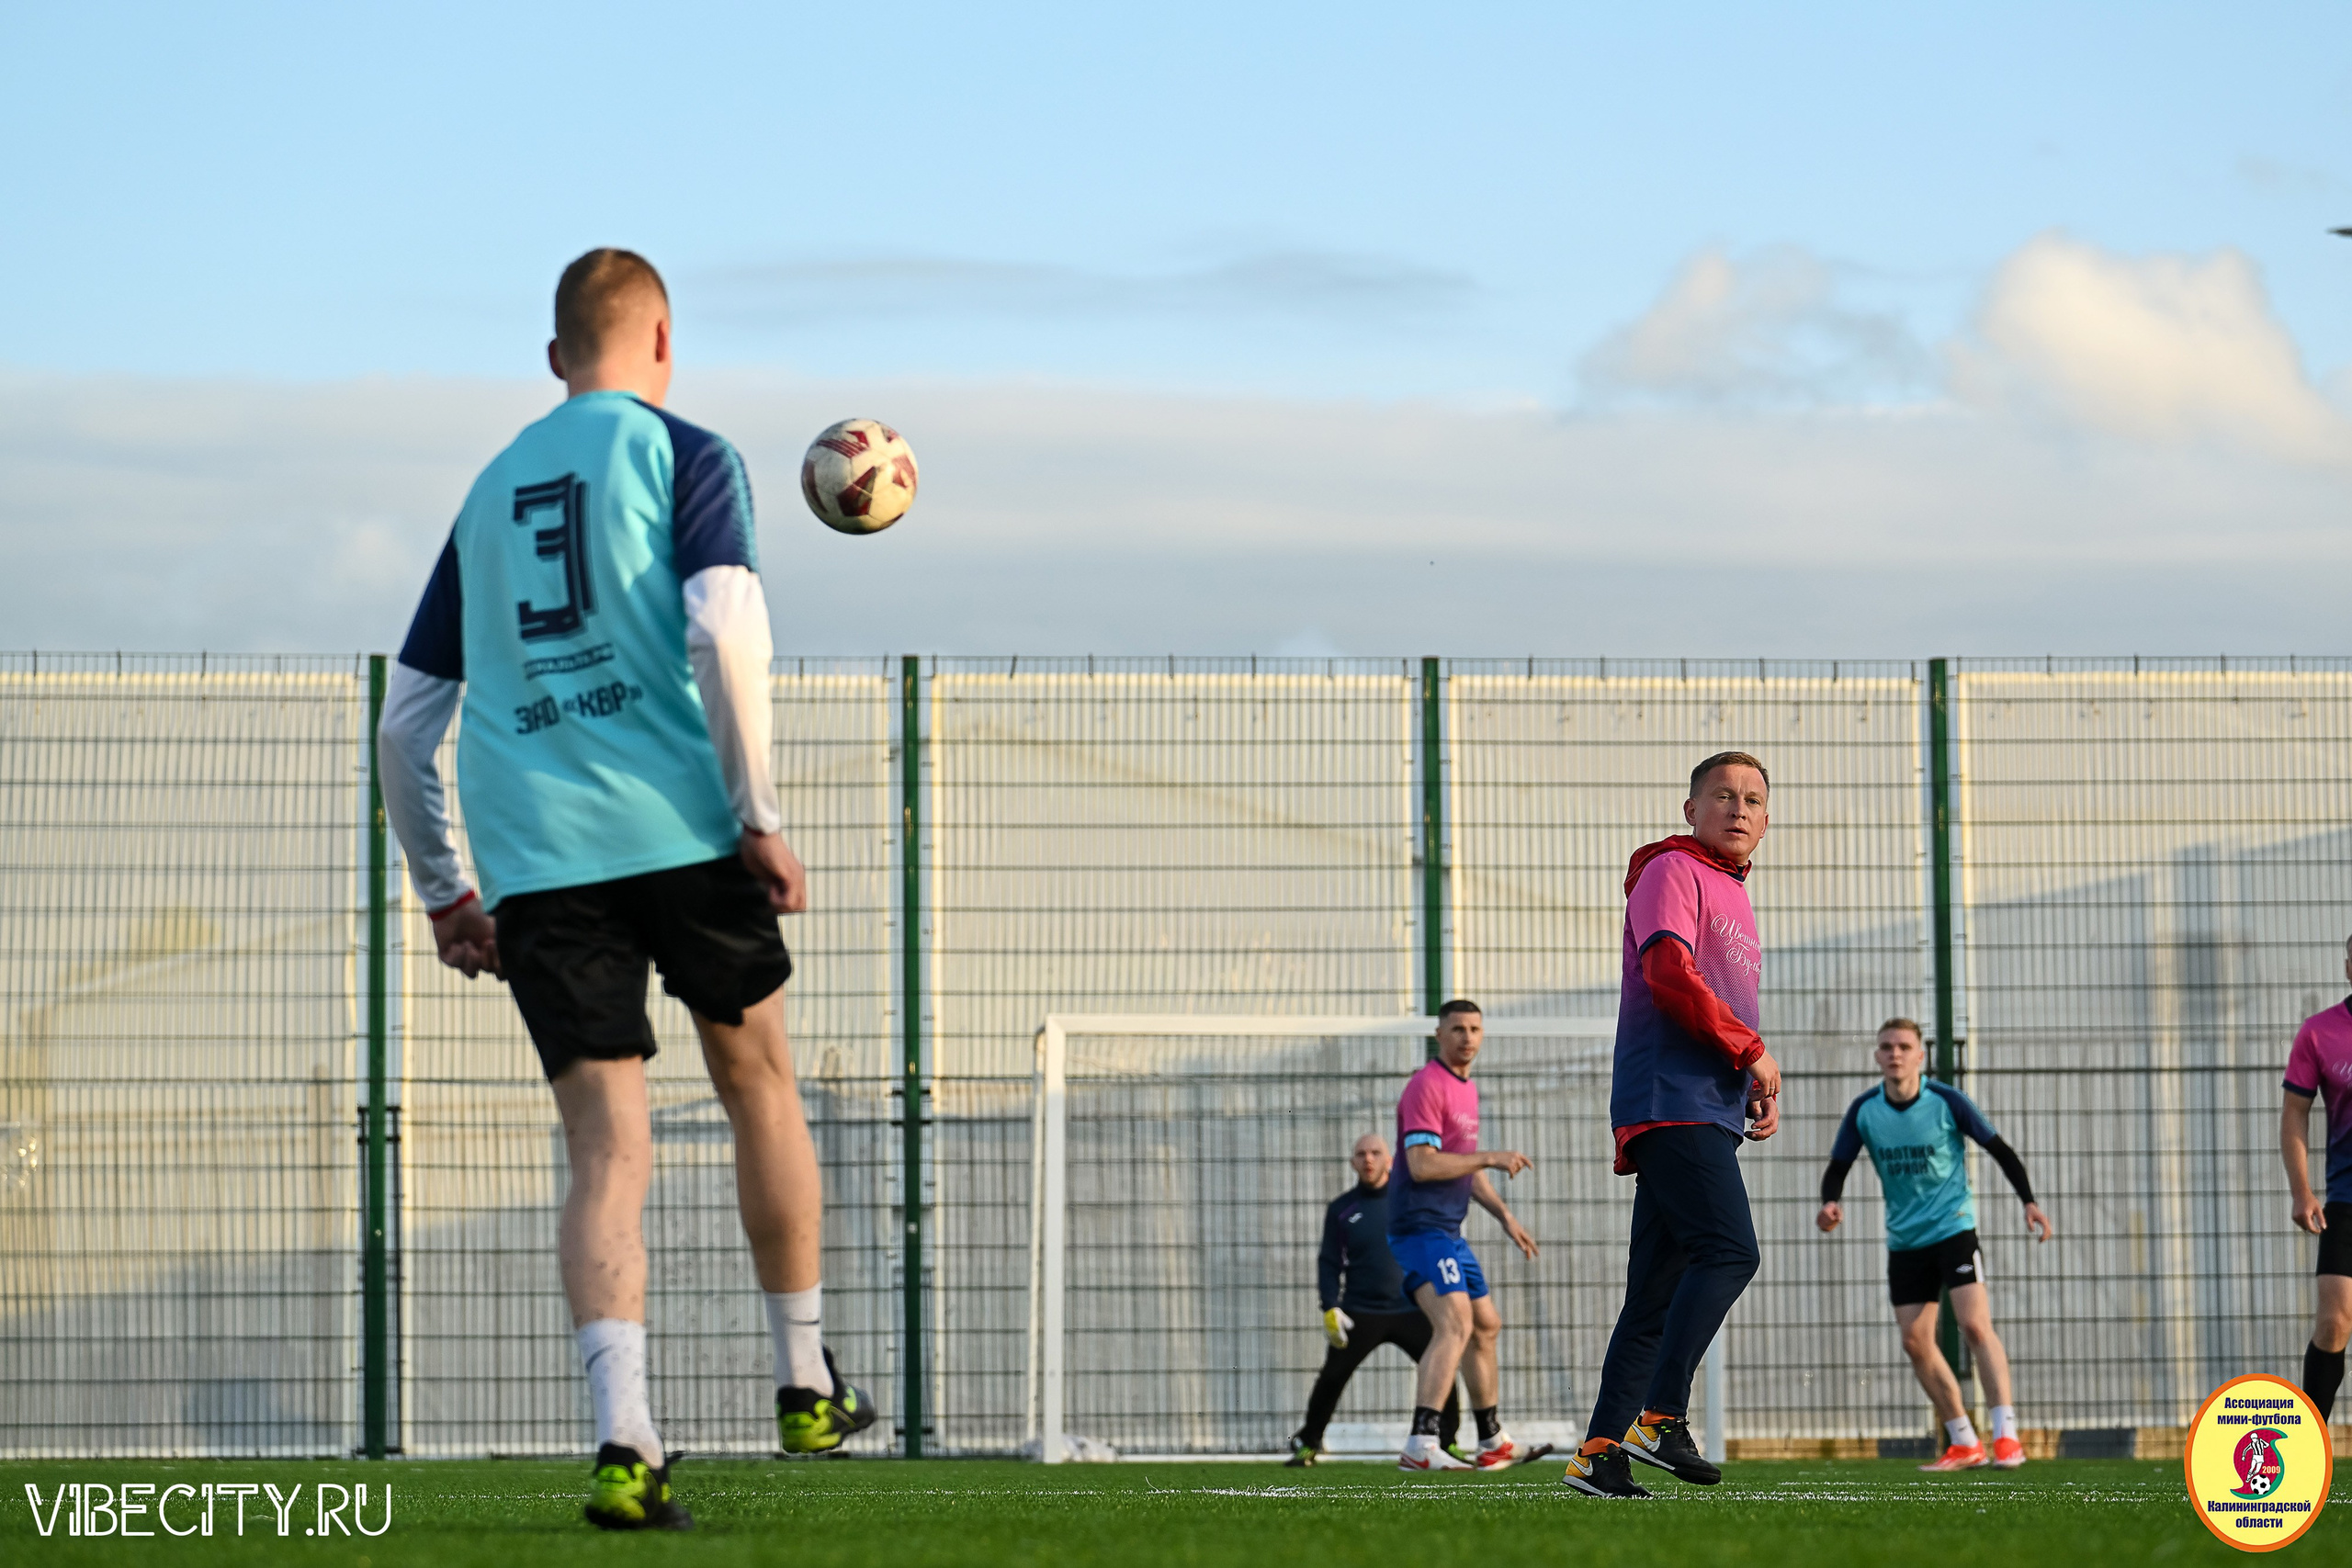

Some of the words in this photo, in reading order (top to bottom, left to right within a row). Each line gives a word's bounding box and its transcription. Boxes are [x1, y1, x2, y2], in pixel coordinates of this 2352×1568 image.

[513, 471, 596, 644] 3
[514, 694, 560, 735] ЗАО
[1437, 1257, 1462, 1285] 13
